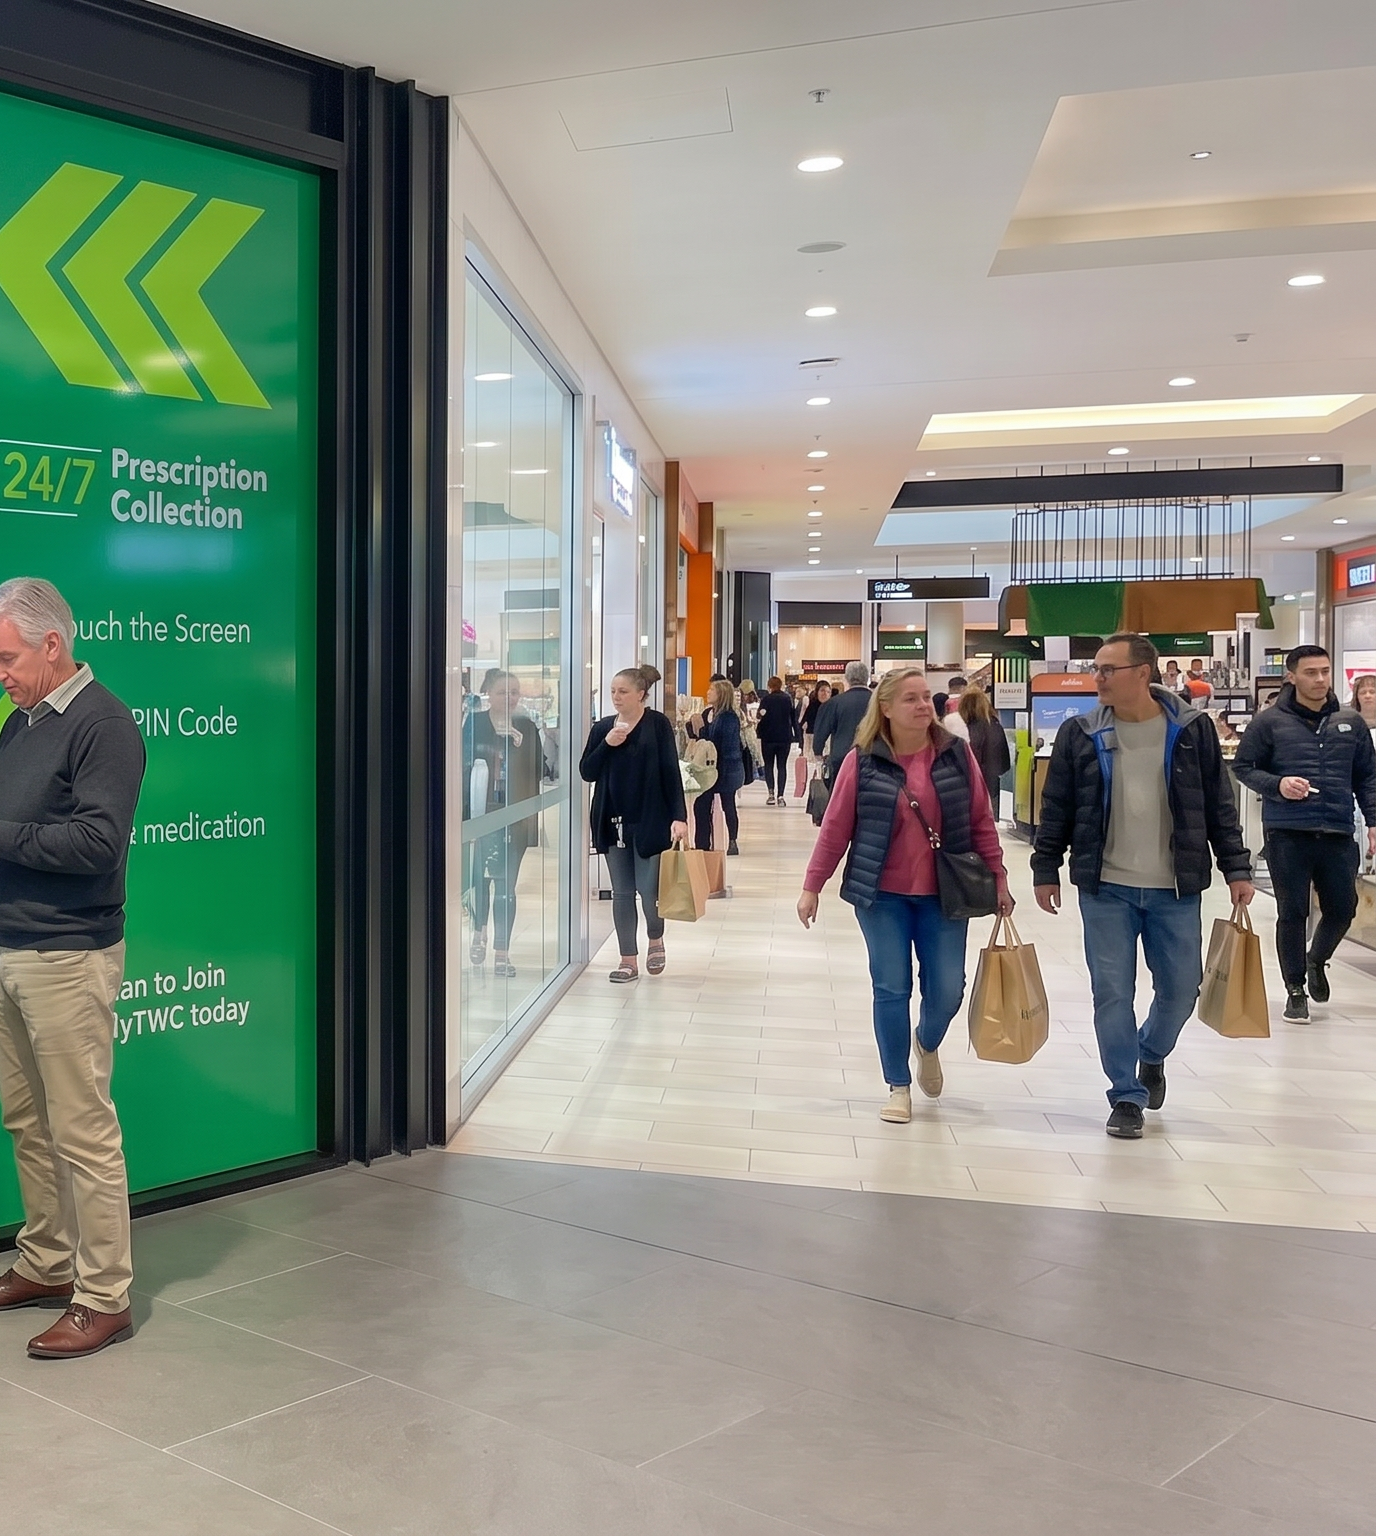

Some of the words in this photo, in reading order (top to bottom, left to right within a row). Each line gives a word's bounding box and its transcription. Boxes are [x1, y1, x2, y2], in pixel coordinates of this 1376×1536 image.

[3, 452, 95, 504] 24/7
[111, 448, 267, 496] Prescription
[111, 489, 242, 529] Collection
[129, 612, 168, 641] the
[176, 614, 250, 643] Screen
[132, 708, 169, 736] PIN
[178, 706, 237, 735] Code
[144, 811, 265, 844] medication
[153, 972, 177, 995] to
[183, 963, 225, 990] Join
[190, 997, 250, 1027] today
